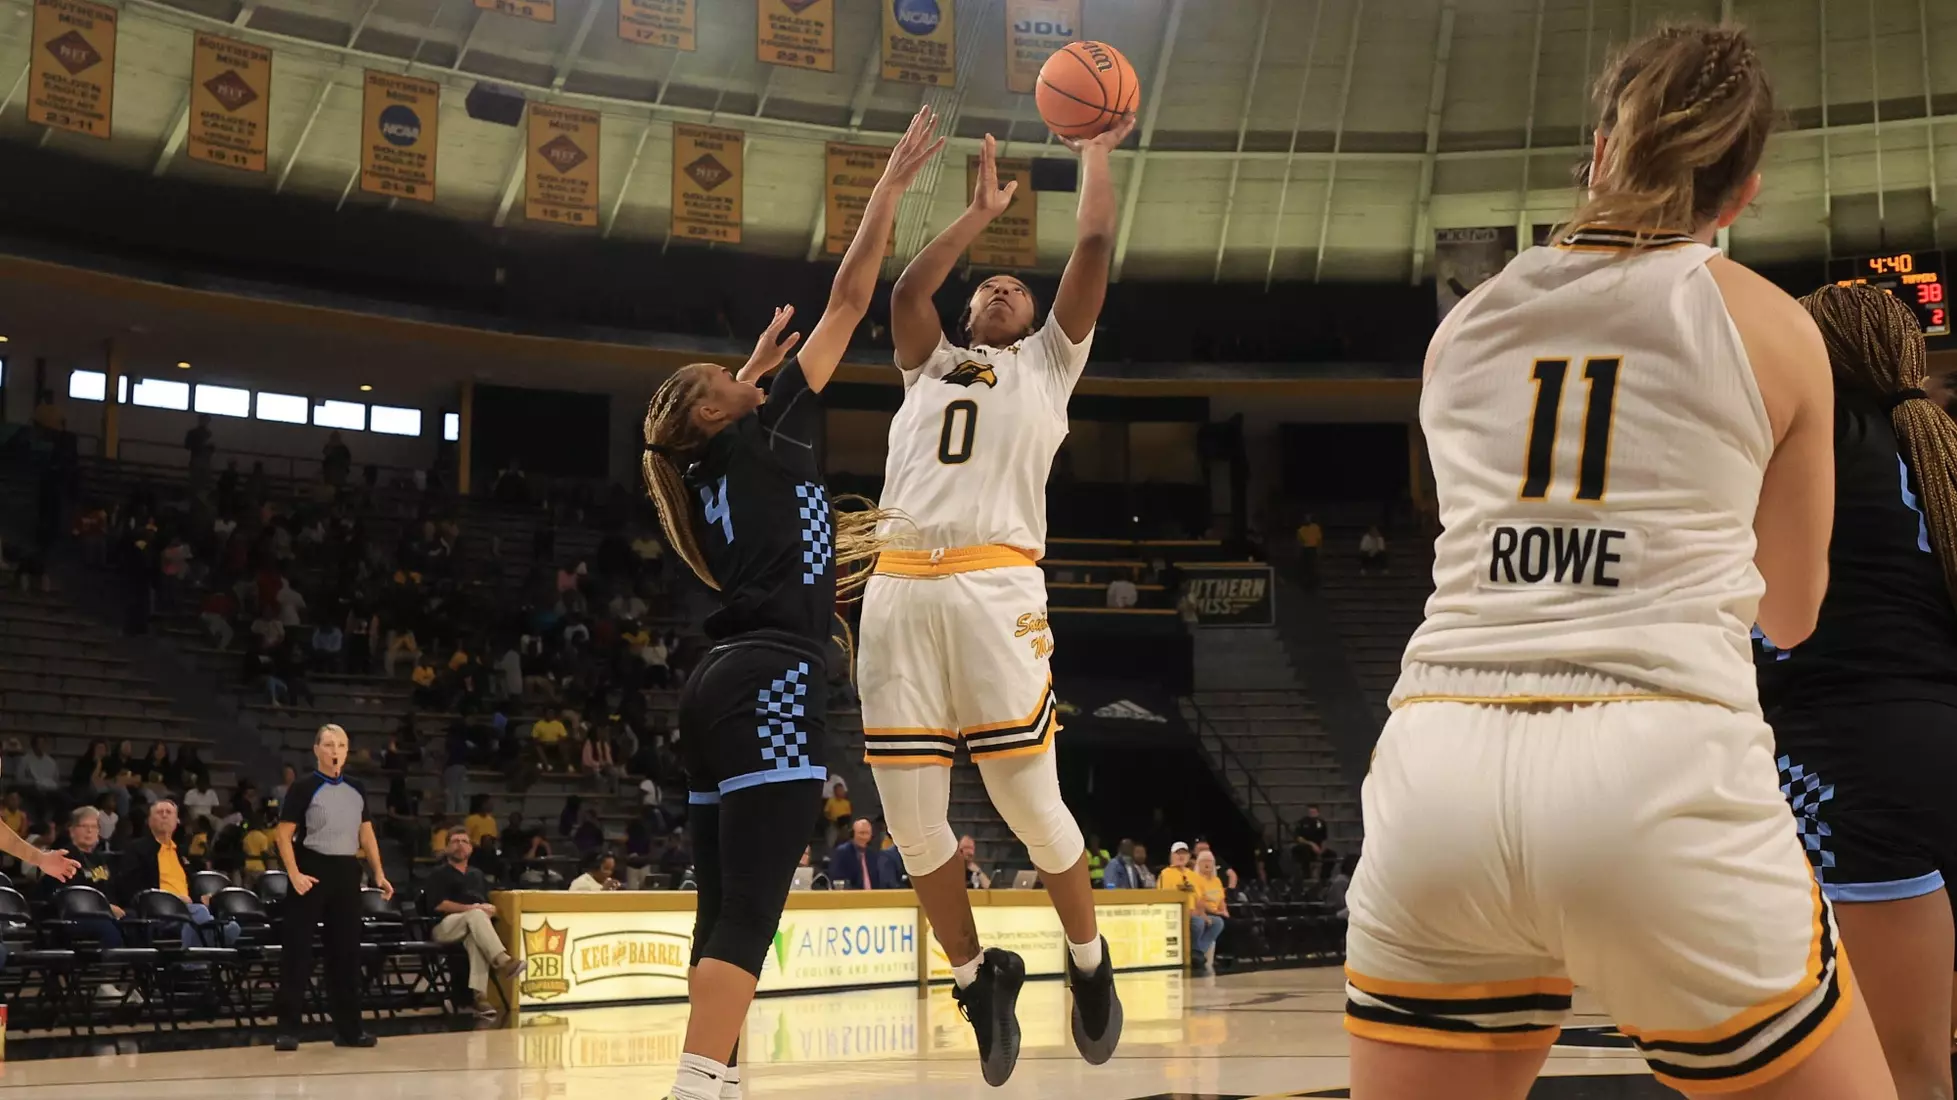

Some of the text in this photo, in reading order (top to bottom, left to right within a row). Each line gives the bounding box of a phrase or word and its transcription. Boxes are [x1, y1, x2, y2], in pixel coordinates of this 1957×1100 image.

[899, 8, 938, 26] NCAA
[60, 44, 90, 61] NIT
[198, 37, 268, 61] SOUTHERN
[368, 75, 437, 95] SOUTHERN
[531, 104, 599, 123] SOUTHERN
[383, 121, 420, 139] NCAA
[695, 166, 721, 179] NIT
[1869, 253, 1913, 274] 4:40
[1916, 283, 1943, 304] 38
[1931, 308, 1944, 325] 2
[937, 398, 979, 466] 0
[1517, 355, 1625, 505] 11
[700, 473, 735, 545] 4
[1489, 526, 1626, 588] ROWE
[1188, 578, 1266, 597] UTHERN
[797, 924, 914, 958] AIRSOUTH
[580, 944, 611, 972] KEG
[628, 940, 683, 967] BARREL
[795, 965, 842, 978] COOLING
[849, 964, 868, 975] AND
[874, 961, 916, 974] HEATING
